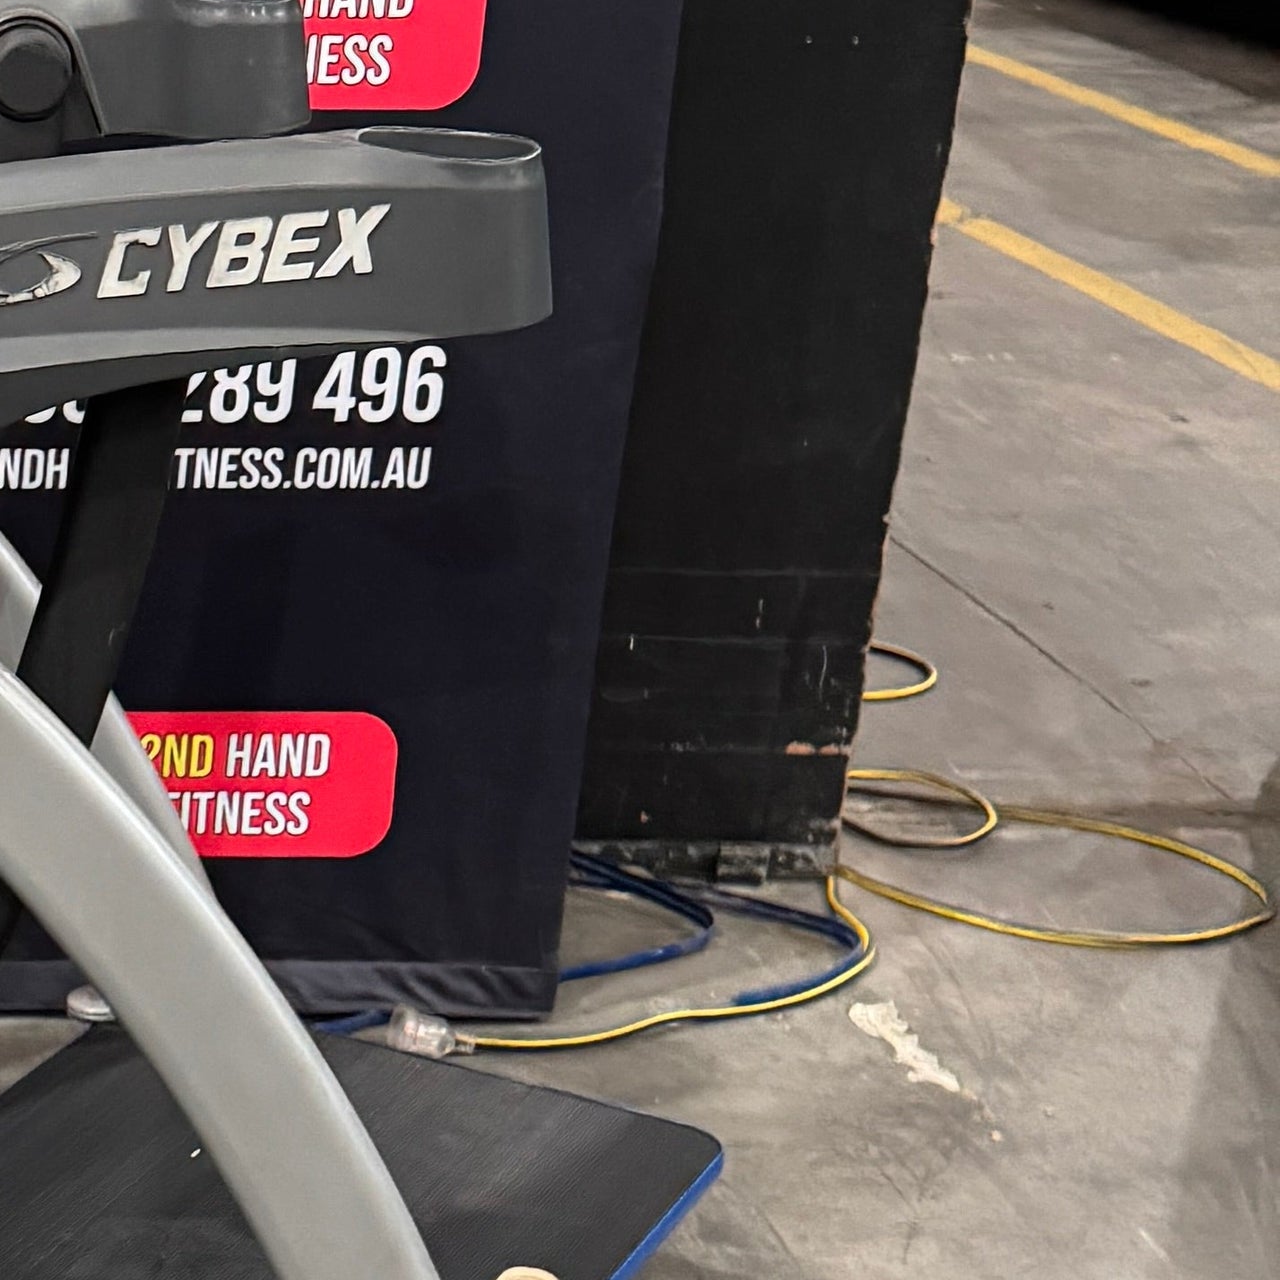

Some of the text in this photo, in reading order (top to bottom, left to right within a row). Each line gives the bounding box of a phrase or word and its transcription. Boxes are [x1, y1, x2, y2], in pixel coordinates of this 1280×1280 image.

[98, 204, 391, 298] CYBEX
[312, 345, 447, 424] 496
[226, 723, 331, 778] HAND
[168, 791, 311, 836] ITNESS
